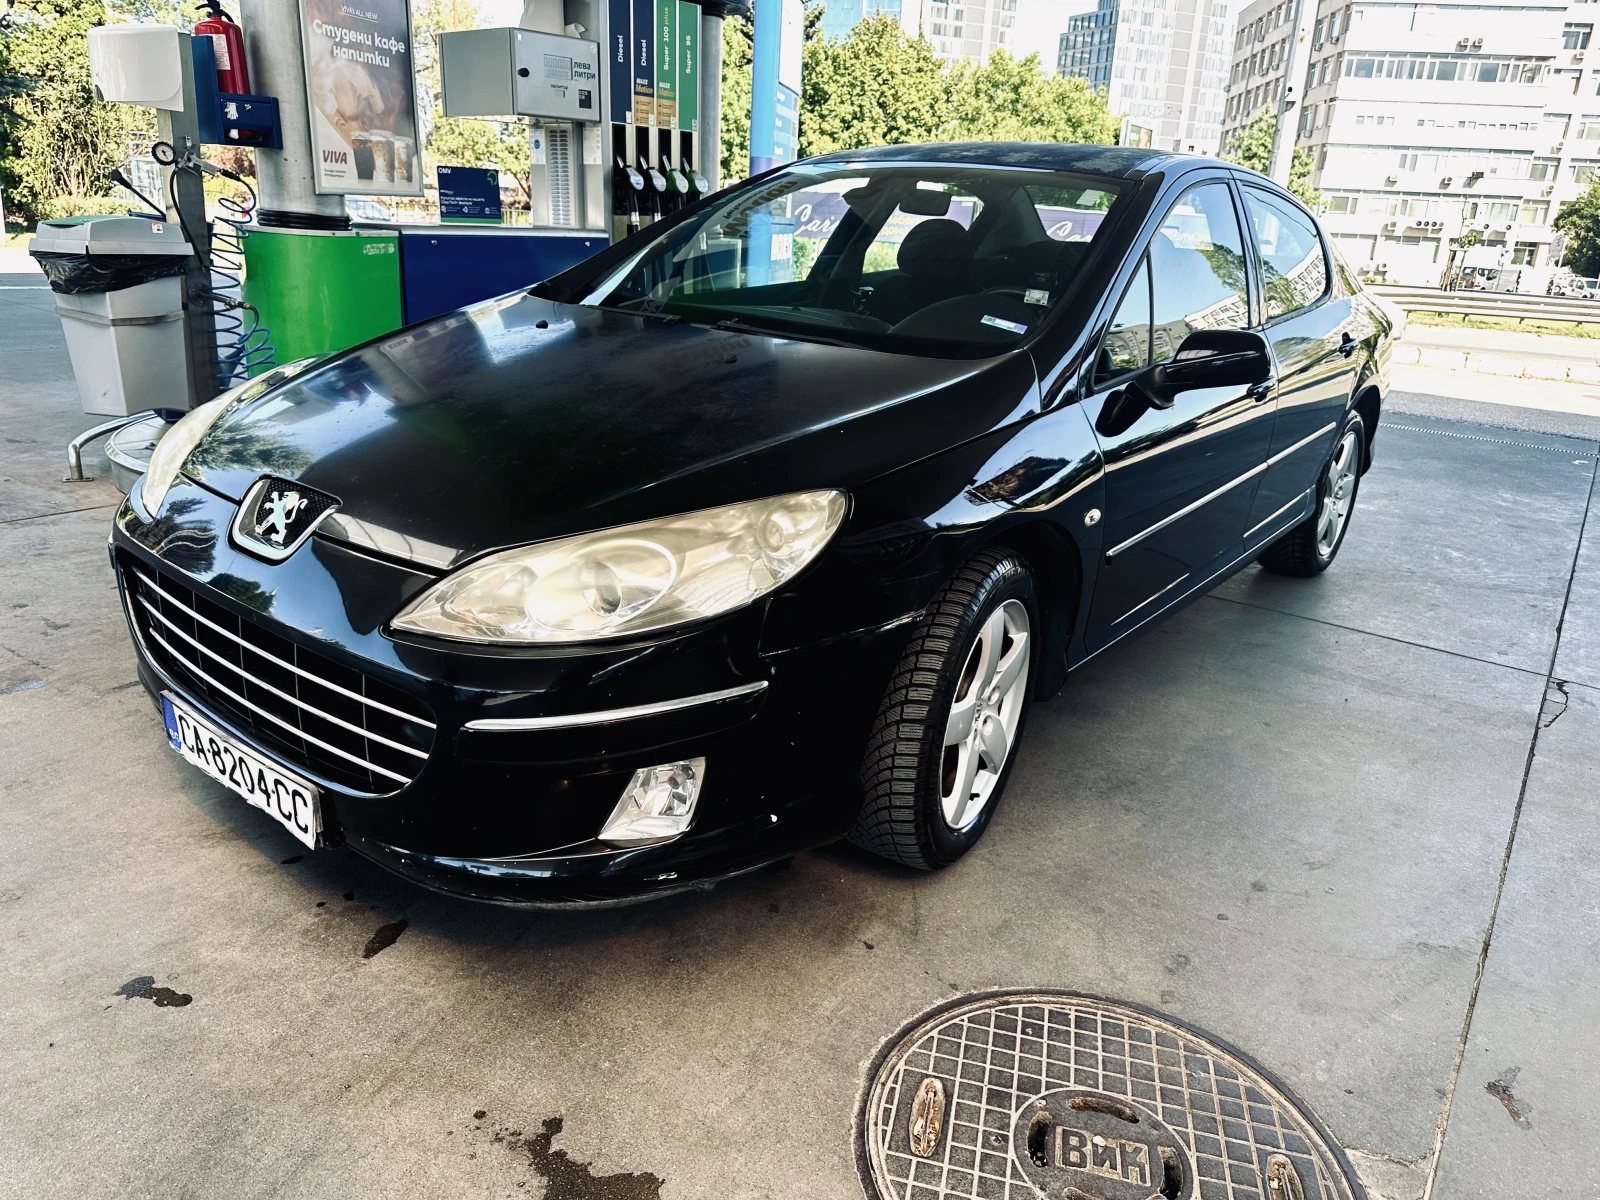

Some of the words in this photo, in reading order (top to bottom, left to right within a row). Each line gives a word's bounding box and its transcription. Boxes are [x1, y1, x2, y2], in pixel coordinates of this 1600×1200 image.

[356, 9, 365, 17] ALL
[365, 12, 378, 20] NEW
[313, 18, 372, 45] Студени
[374, 32, 405, 55] кафе
[685, 35, 691, 46] 95
[332, 45, 390, 68] напитки
[573, 61, 591, 71] лева
[573, 70, 596, 81] литри
[635, 84, 654, 94] Motion
[322, 149, 347, 165] VIVA
